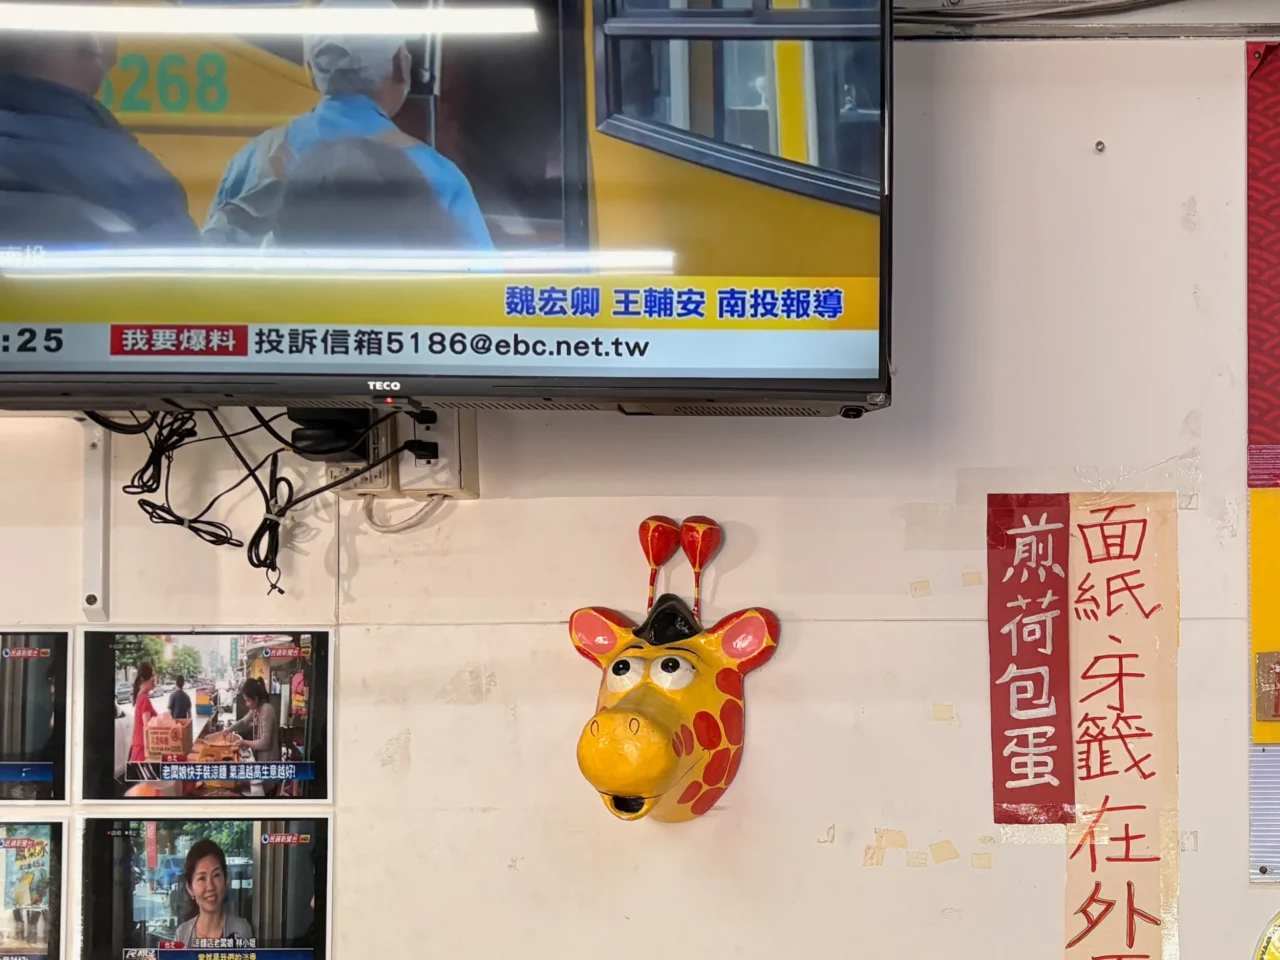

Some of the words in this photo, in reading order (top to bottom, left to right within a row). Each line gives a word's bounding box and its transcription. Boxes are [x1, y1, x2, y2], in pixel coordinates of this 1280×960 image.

[103, 51, 229, 113] 268
[505, 286, 600, 317] 魏宏卿
[611, 288, 706, 318] 王輔安
[717, 288, 843, 319] 南投報導
[122, 329, 236, 351] 我要爆料
[254, 329, 649, 357] 投訴信箱5186@ebc.net.tw
[367, 382, 400, 390] TECO
[995, 514, 1064, 789] 煎荷包蛋
